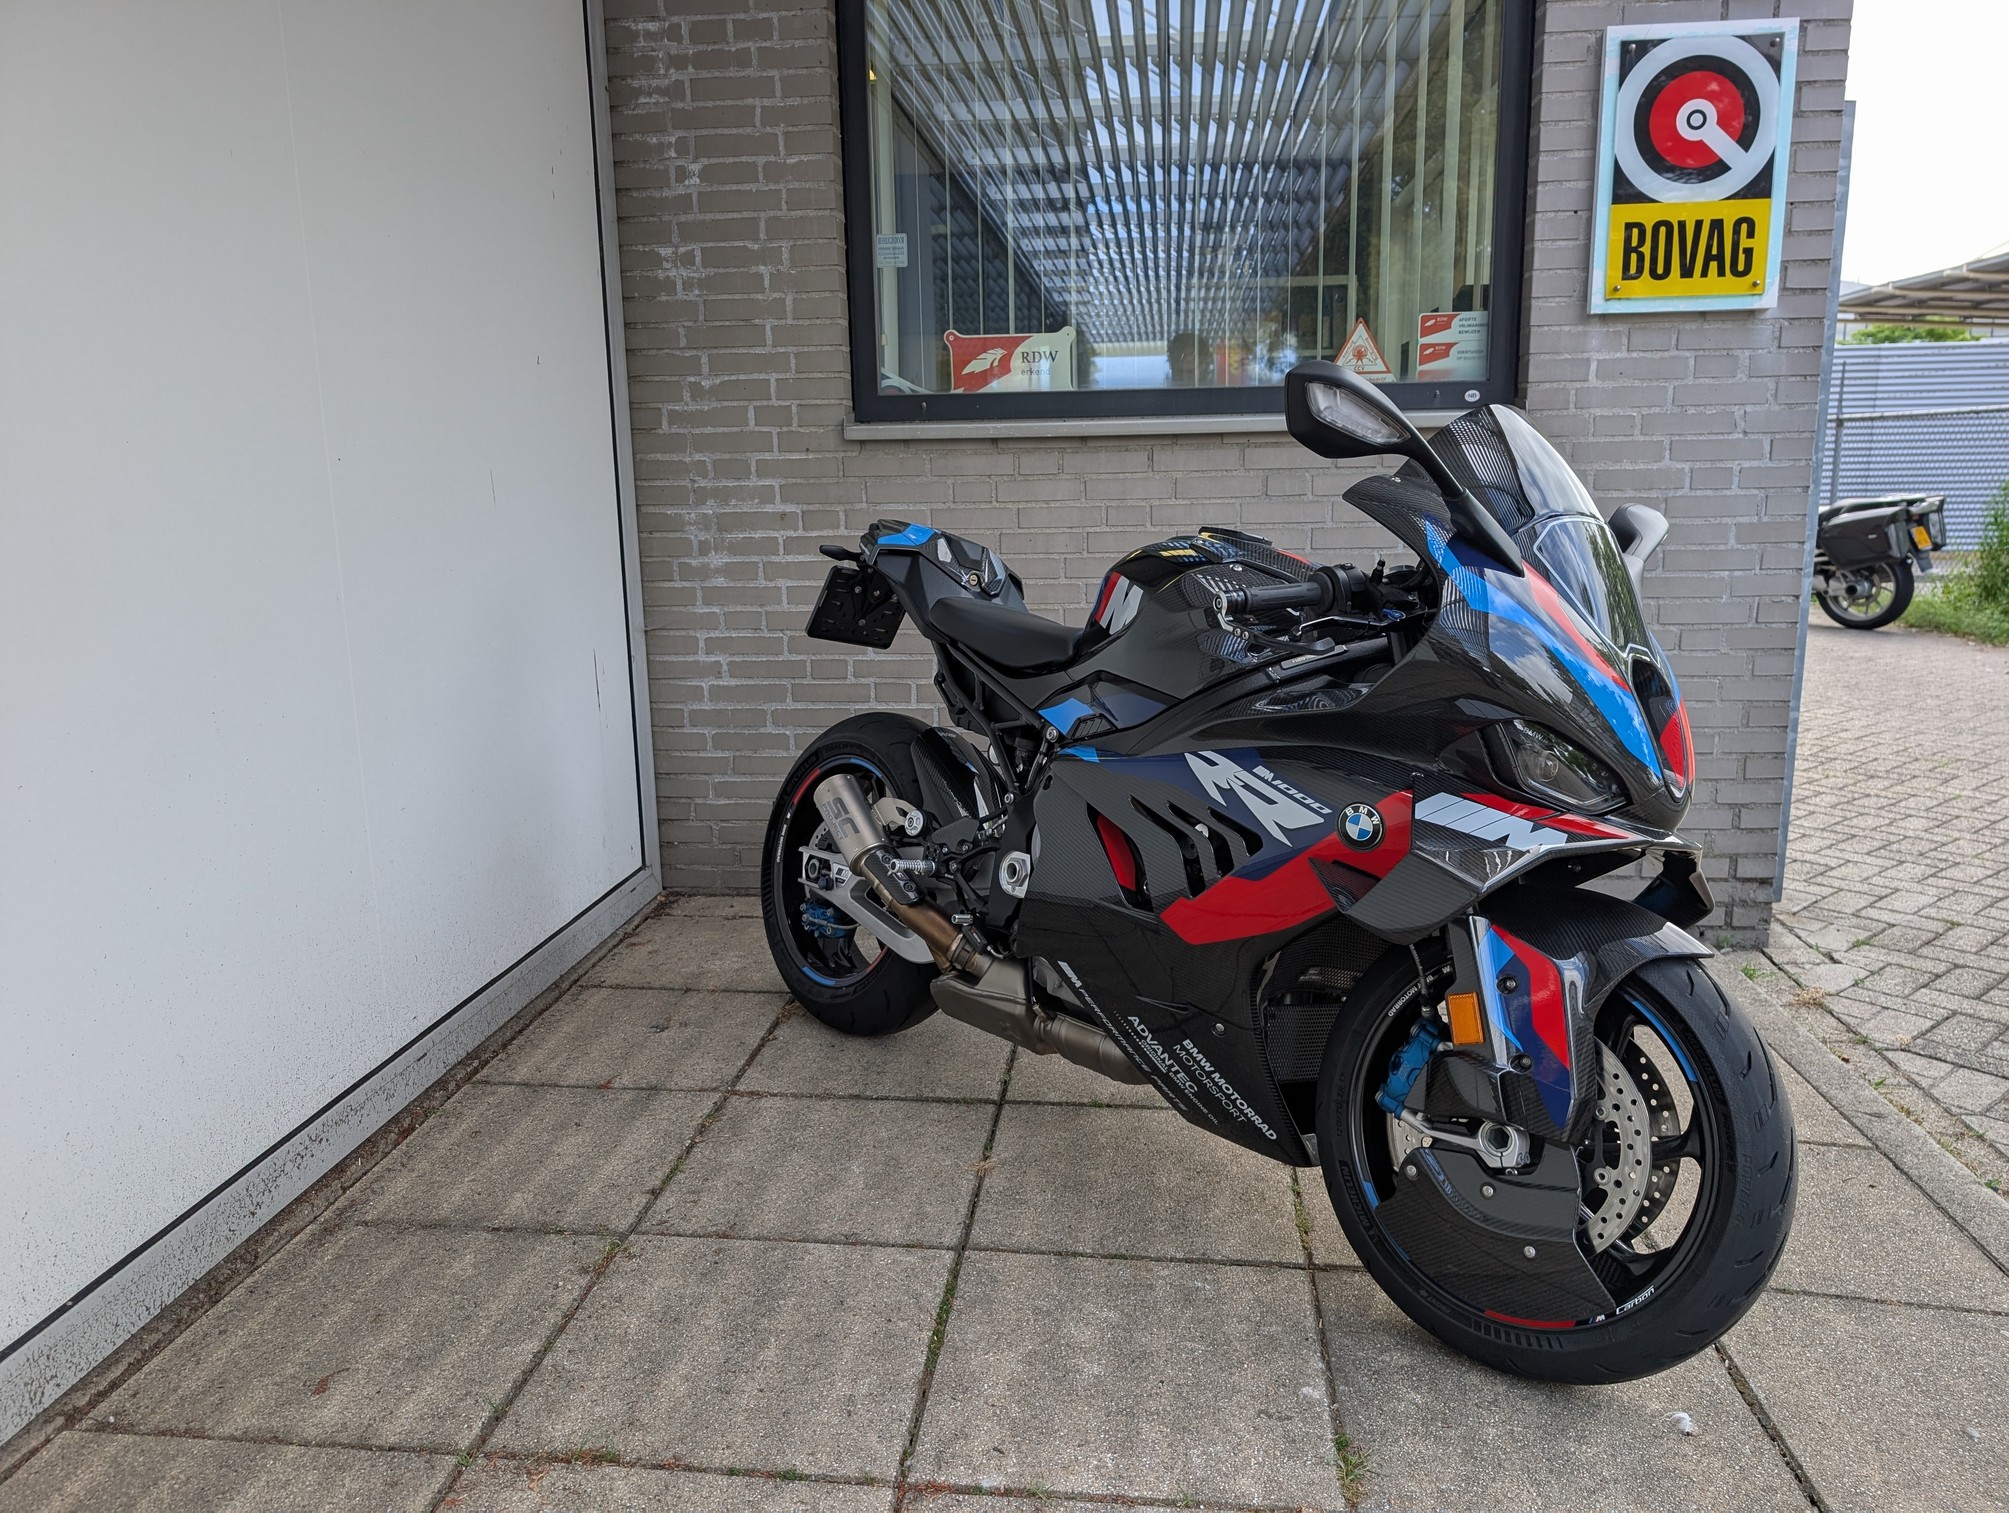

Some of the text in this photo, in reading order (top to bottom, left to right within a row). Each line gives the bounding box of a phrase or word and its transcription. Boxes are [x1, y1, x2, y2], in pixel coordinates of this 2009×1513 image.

[1621, 216, 1756, 281] BOVAG
[1021, 350, 1059, 363] RDW
[1021, 368, 1051, 376] erkend
[825, 796, 860, 839] SC
[1345, 805, 1380, 825] BMW
[1387, 985, 1418, 1017] MOTORRAD
[1128, 1016, 1198, 1093] ADVANTEC
[1140, 1039, 1219, 1126] ORIGINAL BMW ENGINE OIL
[1173, 1044, 1248, 1123] MOTORSPORT
[1182, 1039, 1278, 1140] BMW MOTORRAD
[1616, 1286, 1655, 1315] Carbon
